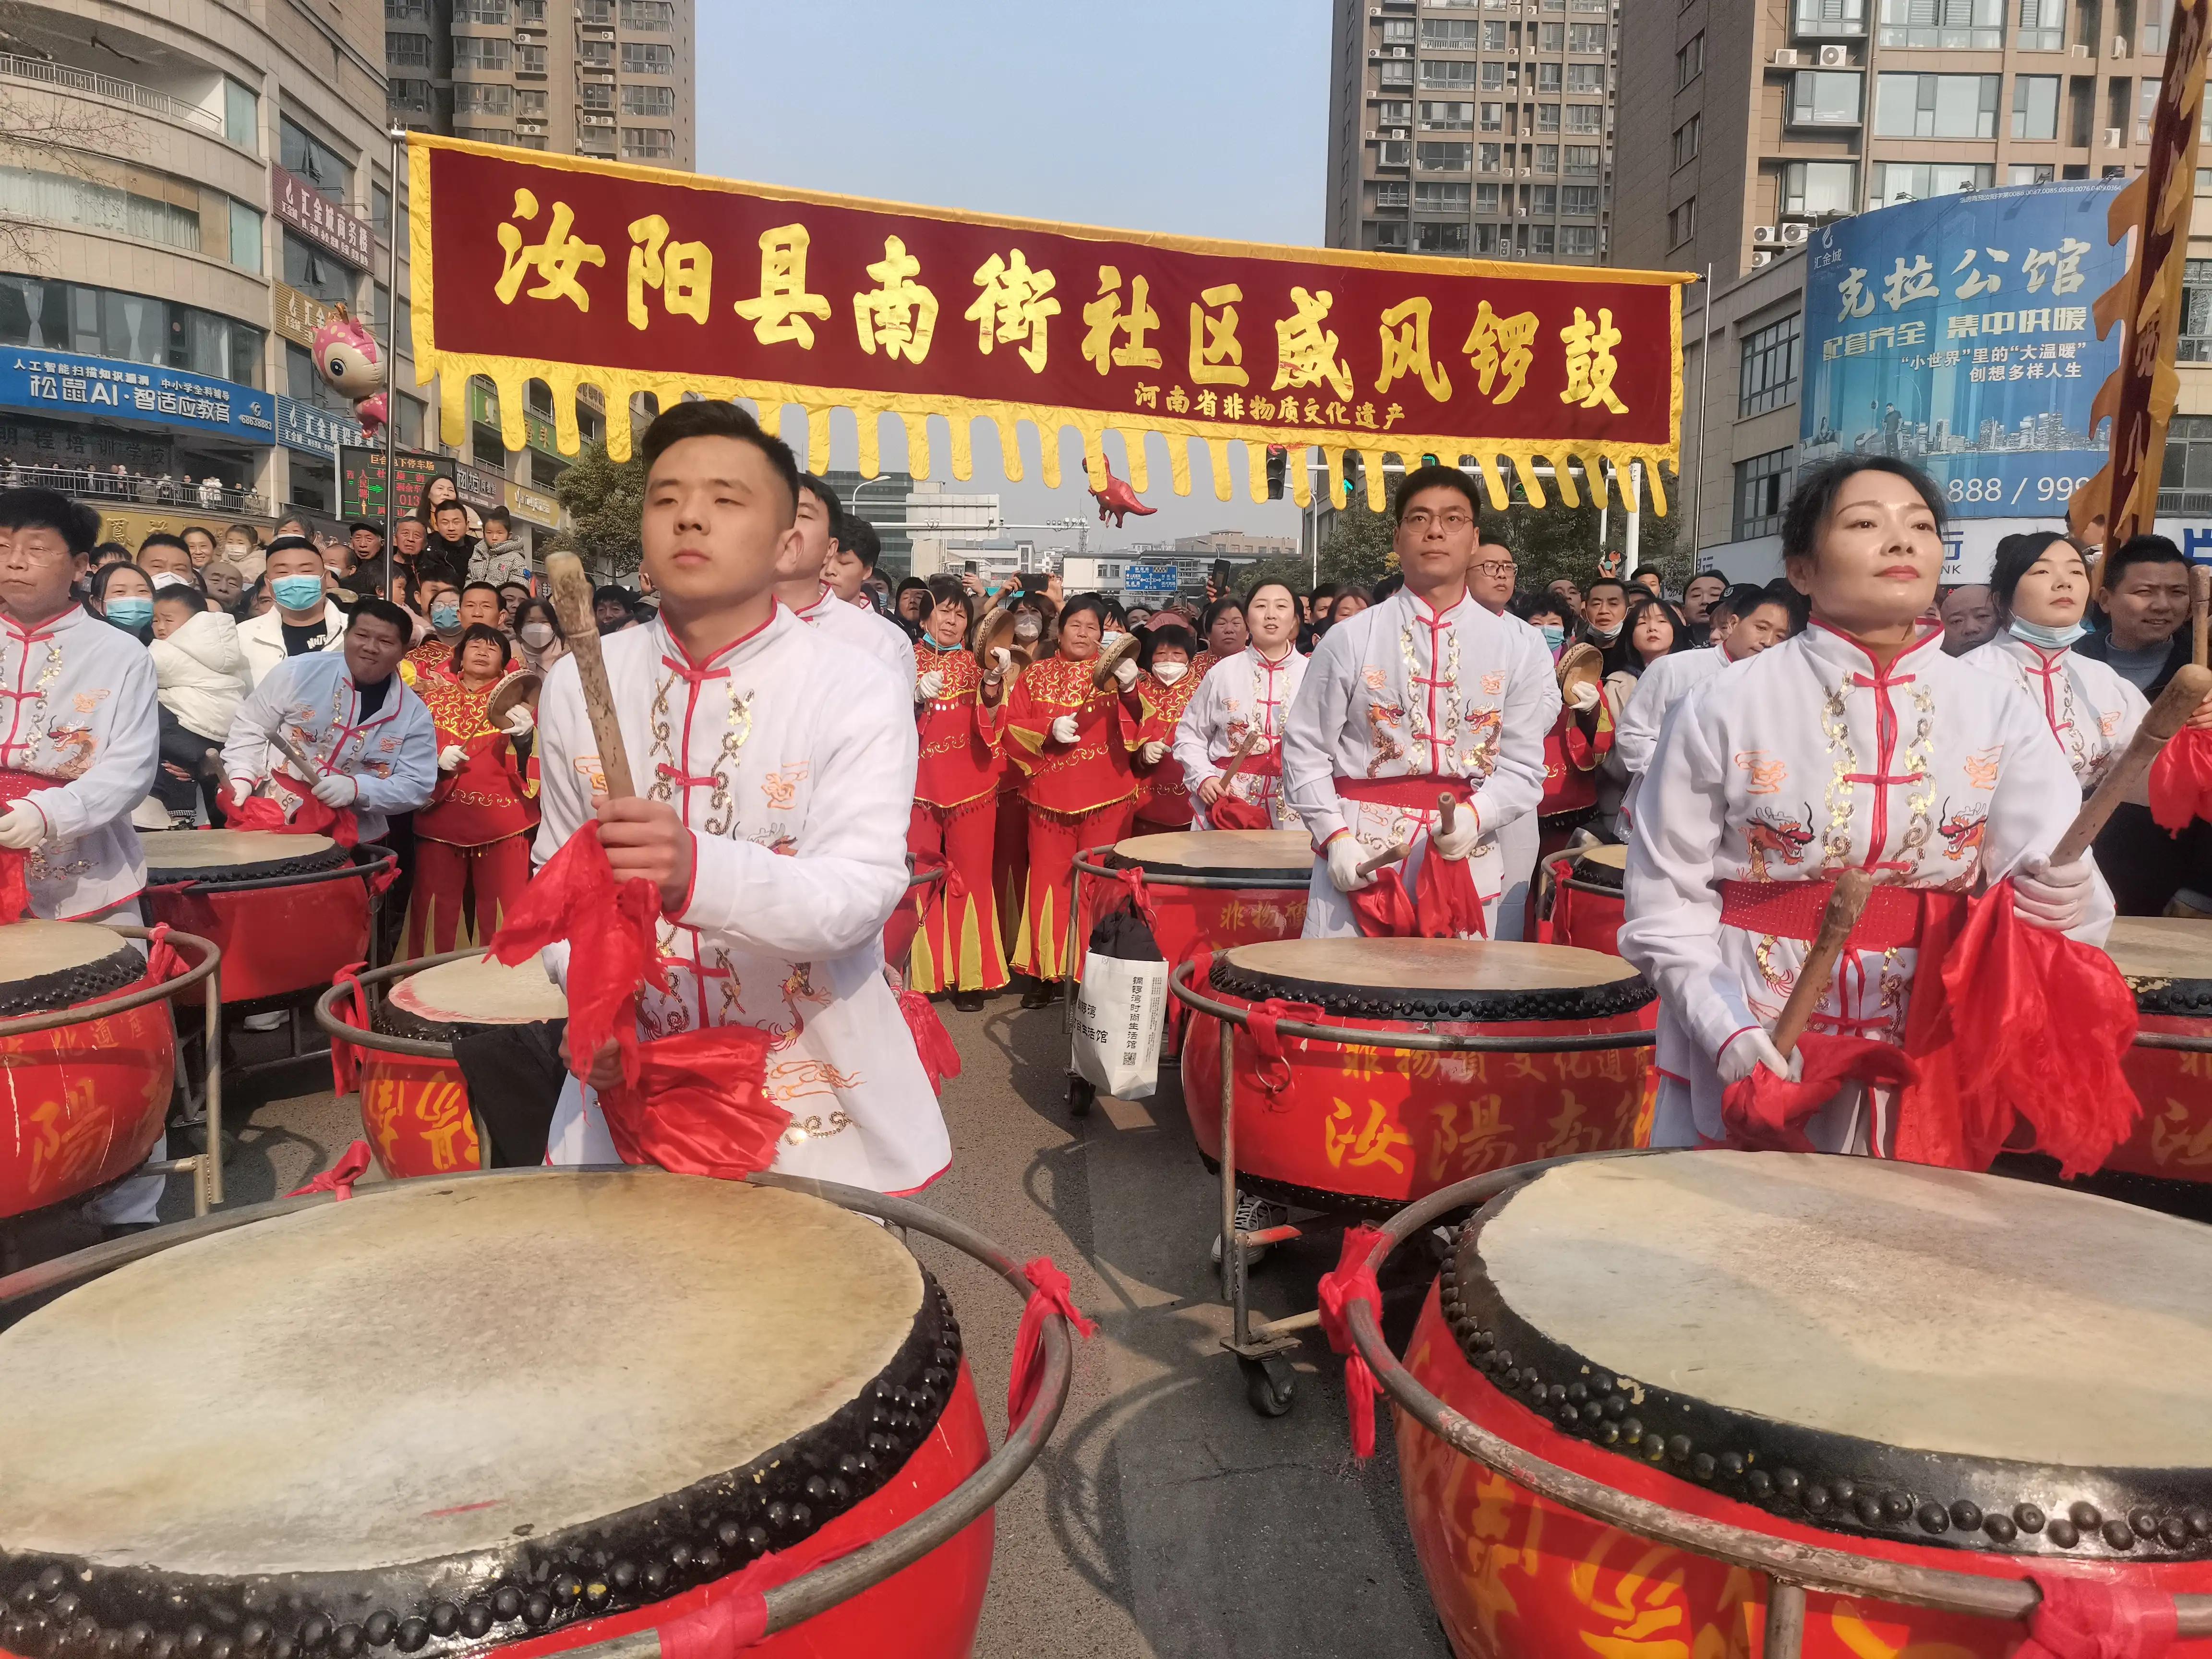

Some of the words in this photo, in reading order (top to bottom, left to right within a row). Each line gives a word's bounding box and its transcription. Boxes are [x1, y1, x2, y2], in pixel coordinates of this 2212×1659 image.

[1814, 248, 1841, 270] 汇金城
[1838, 238, 2091, 322] 克拉公馆
[494, 188, 1629, 415] 汝阳县南街社区威风锣鼓
[1823, 320, 1926, 361] 配套齐全
[1947, 307, 2088, 339] 集中供暖
[13, 359, 150, 386] 人工智能扫描知识漏洞
[161, 378, 230, 401] 中小学全科辅导
[1970, 363, 2081, 383] 创想多样人生
[1134, 382, 1405, 430] 河南省非物质文化遗产
